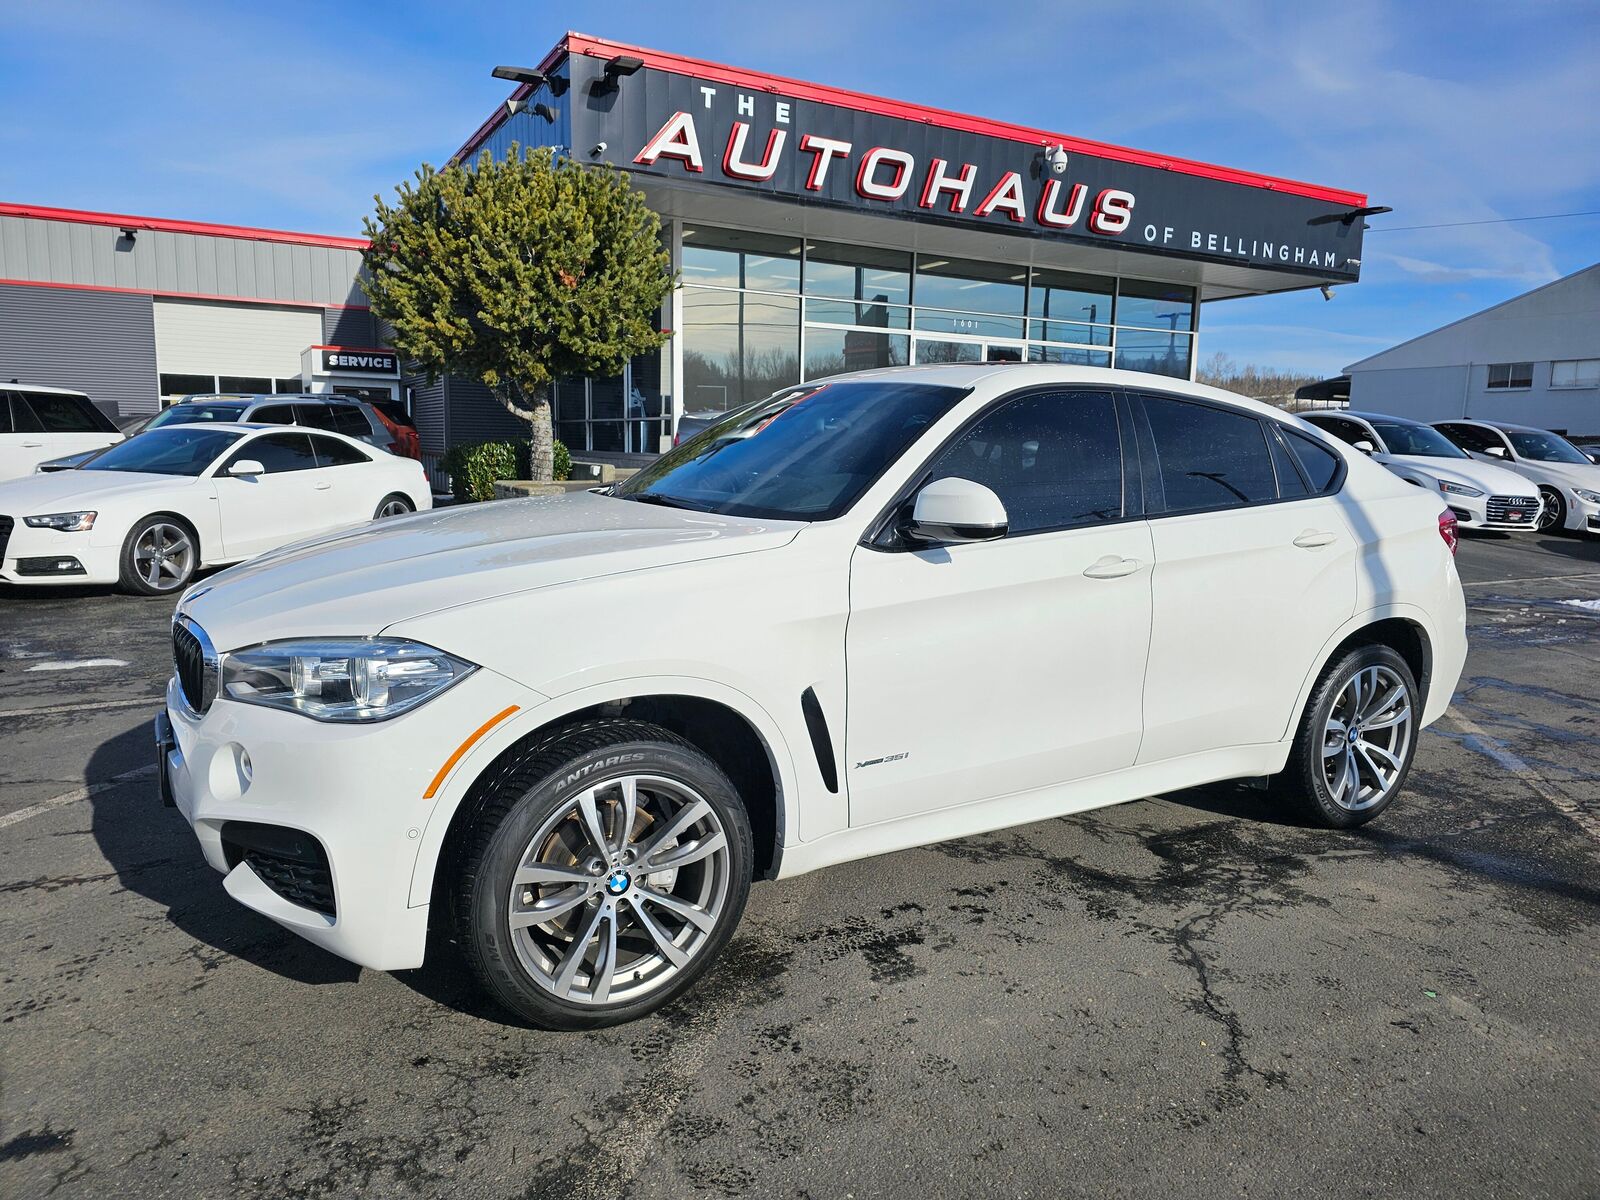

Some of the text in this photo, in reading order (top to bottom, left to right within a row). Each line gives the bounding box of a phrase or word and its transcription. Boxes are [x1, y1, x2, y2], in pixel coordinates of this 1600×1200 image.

[700, 86, 790, 124] THE
[633, 111, 1135, 235] AUTOHAUS
[1144, 224, 1336, 268] OF BELLINGHAM
[953, 319, 978, 329] 1601
[328, 354, 392, 369] SERVICE
[555, 752, 646, 794] ANTARES
